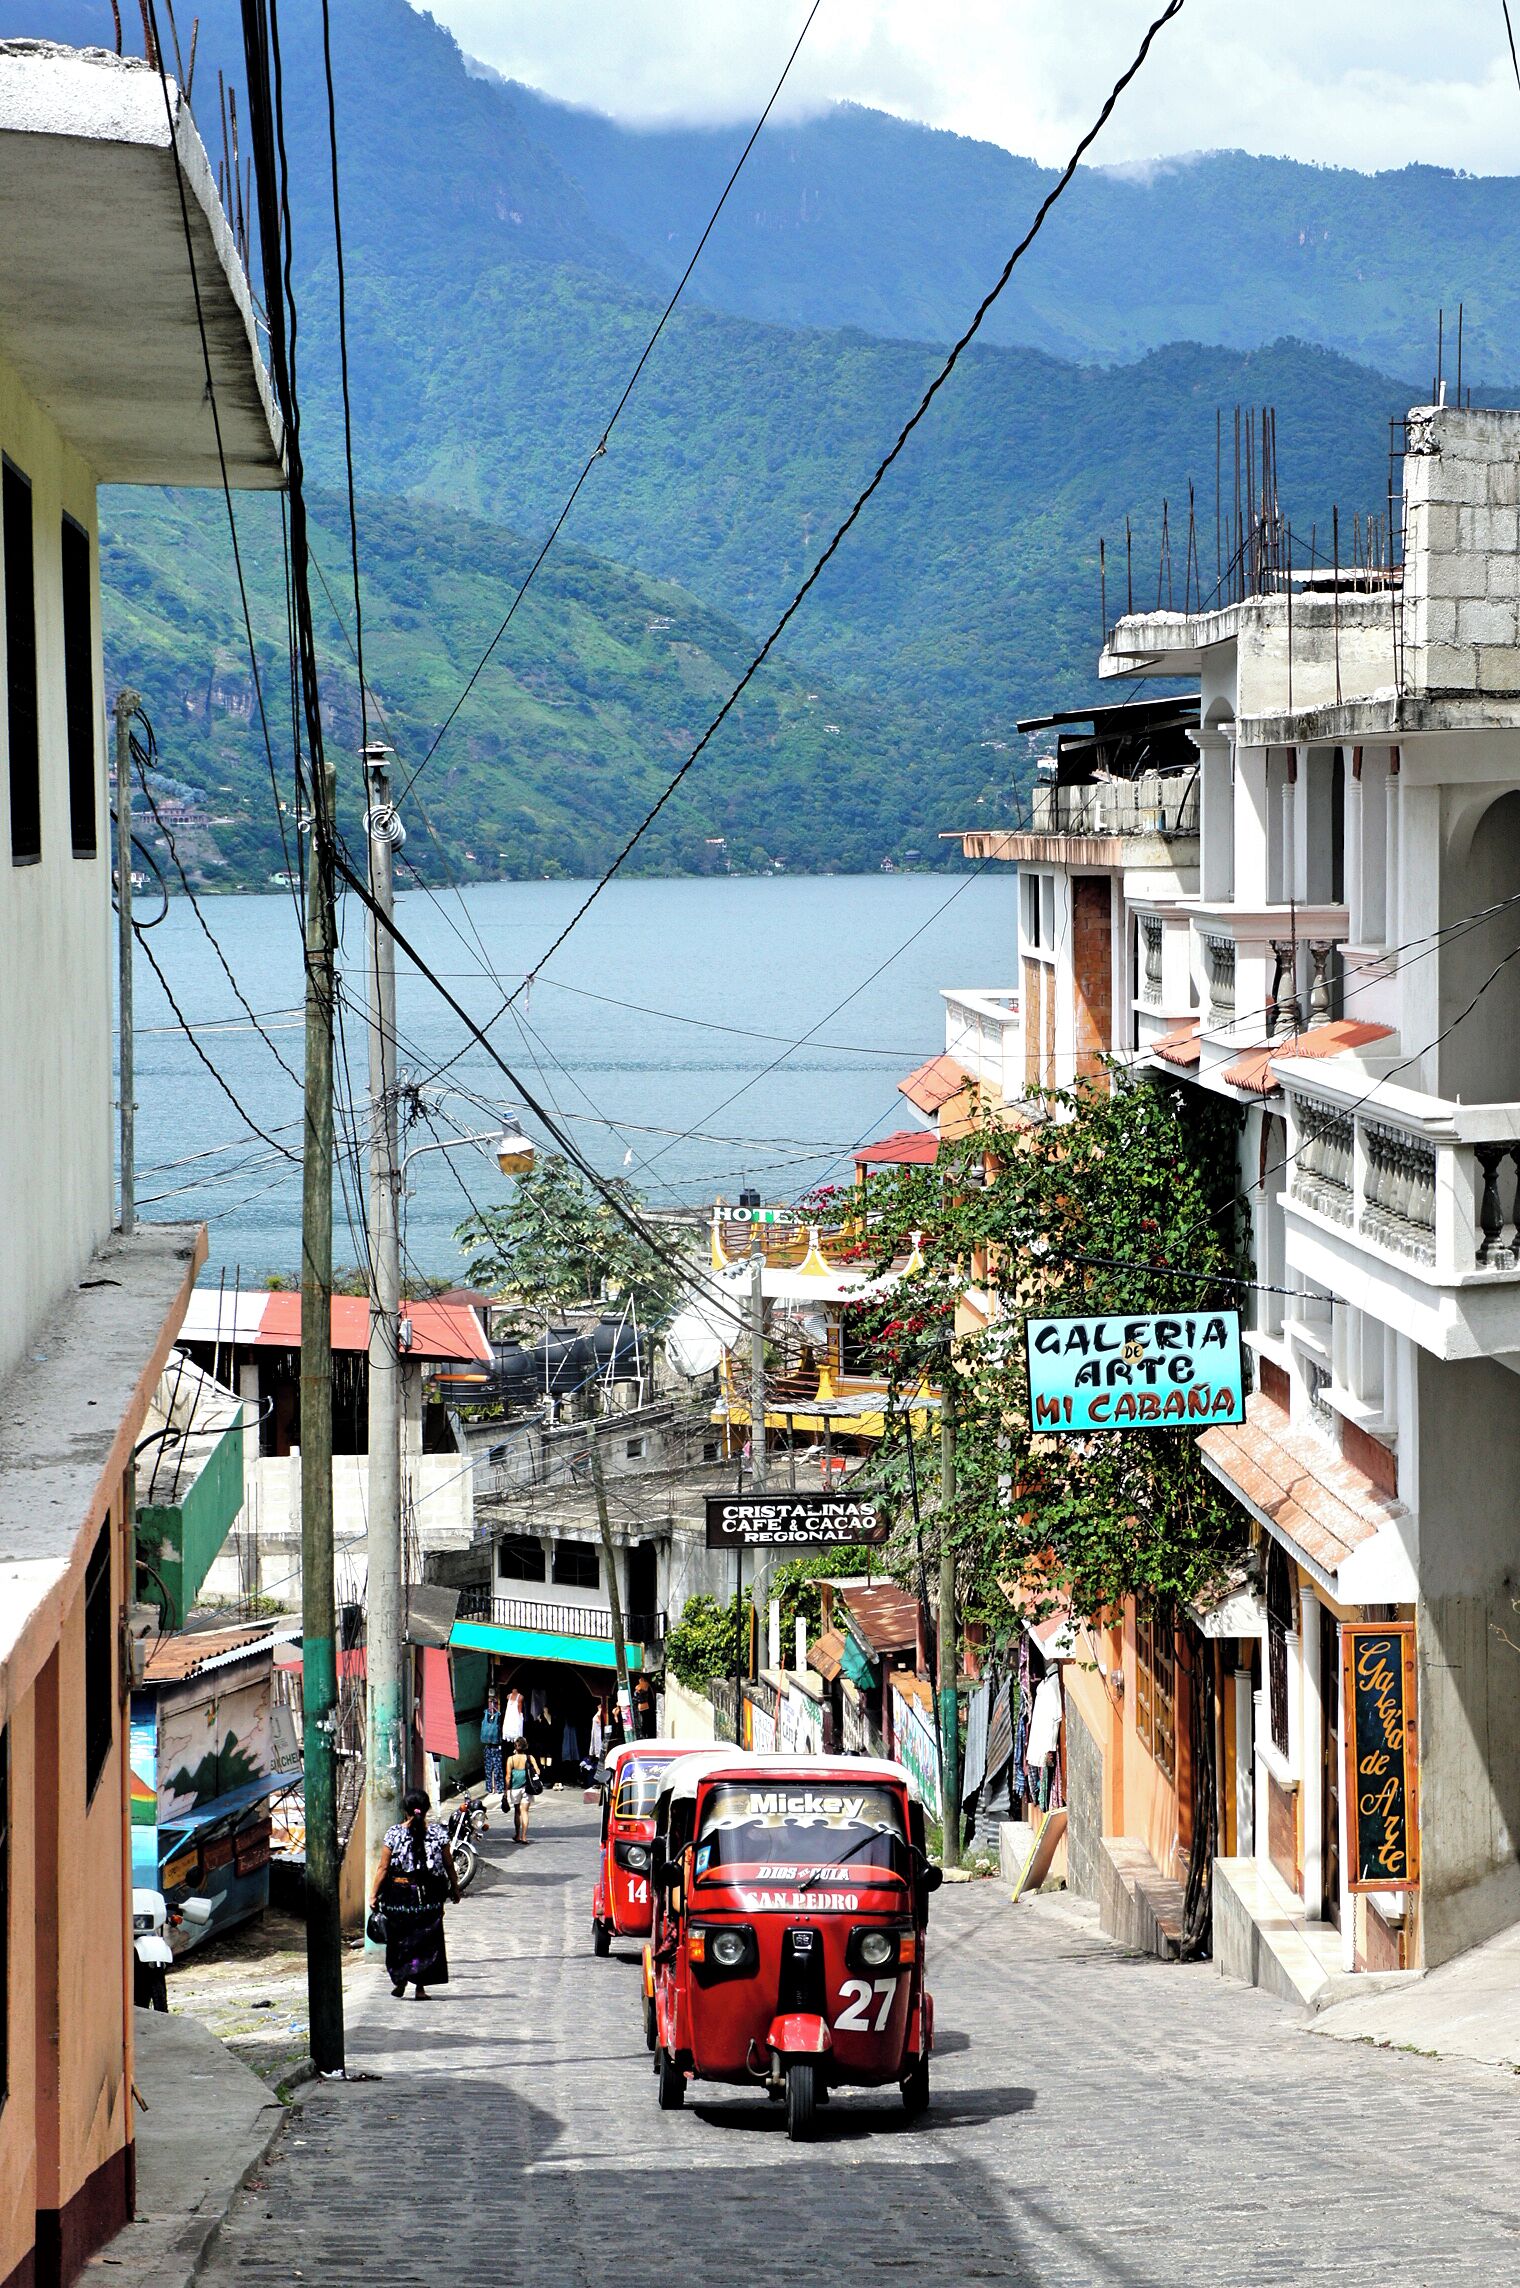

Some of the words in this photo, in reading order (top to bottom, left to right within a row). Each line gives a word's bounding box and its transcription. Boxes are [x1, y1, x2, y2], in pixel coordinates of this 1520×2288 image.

[713, 1206, 813, 1224] HOTE
[1034, 1316, 1228, 1357] GALERIA
[1124, 1344, 1142, 1360] DE
[1074, 1354, 1195, 1388] ARTE
[1035, 1393, 1073, 1426] MI
[1087, 1381, 1236, 1424] CABAÑA
[722, 1503, 875, 1519] CRISTALINAS
[789, 1519, 798, 1531] &
[805, 1516, 877, 1530] CACAO
[744, 1530, 852, 1543] REGIONAL
[1360, 1750, 1390, 1775] de
[750, 1793, 864, 1818] Mickey
[1360, 1776, 1405, 1872] Arte
[756, 1866, 797, 1880] DIOS
[627, 1879, 648, 1904] 14
[744, 1892, 786, 1910] SAN
[792, 1893, 859, 1911] PEDRO
[833, 1977, 897, 2032] 27
